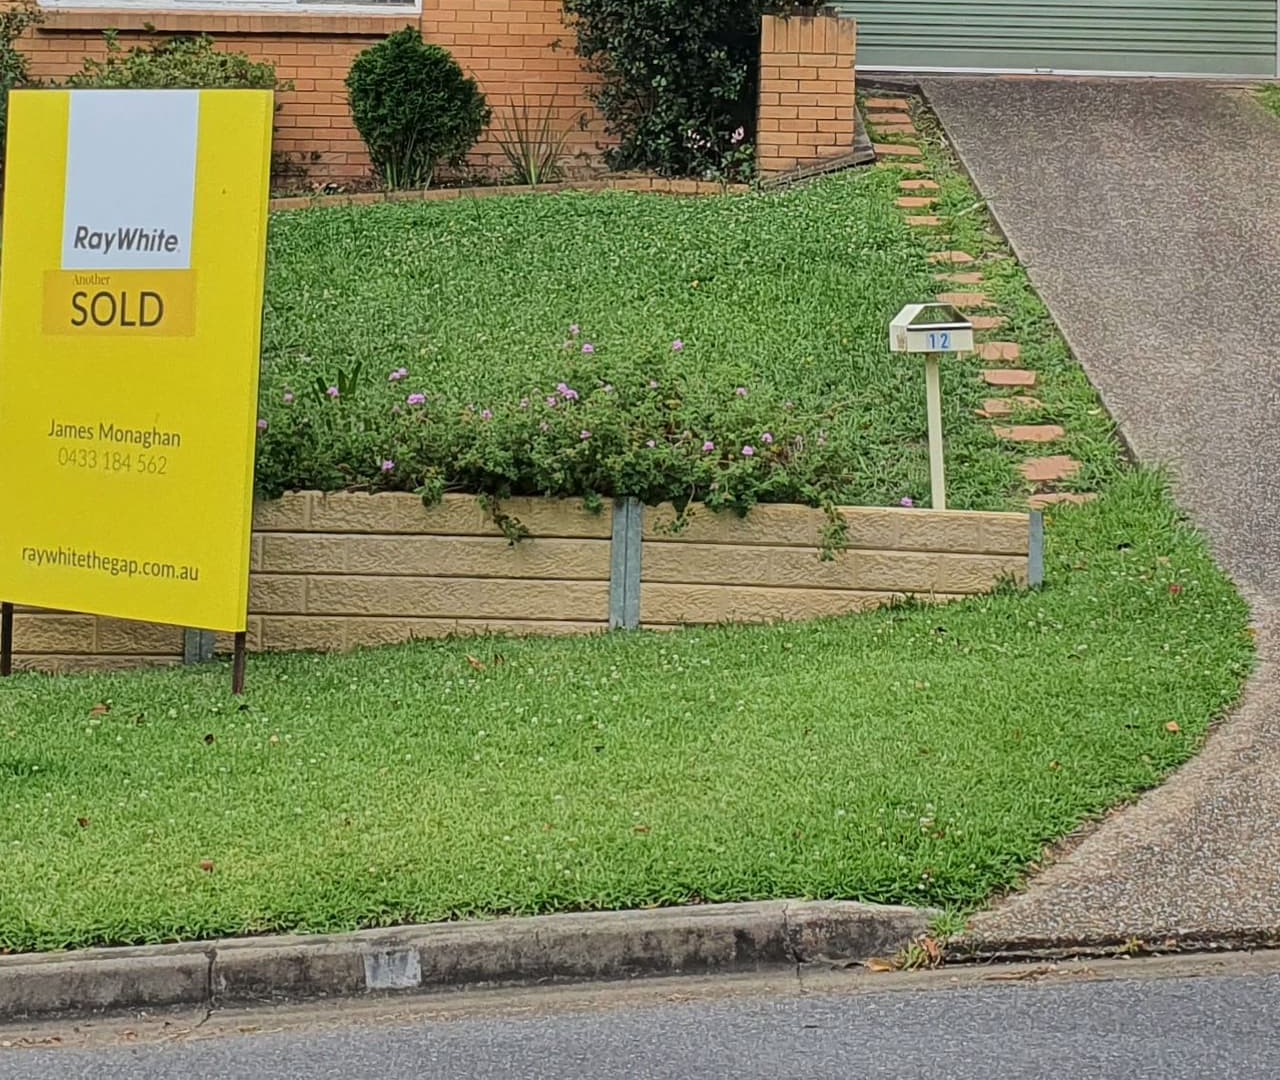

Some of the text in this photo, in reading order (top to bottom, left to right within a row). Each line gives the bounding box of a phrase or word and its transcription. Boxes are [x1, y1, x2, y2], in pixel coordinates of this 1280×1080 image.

[72, 274, 110, 286] Another
[71, 291, 164, 327] SOLD
[930, 333, 949, 349] 12
[48, 419, 181, 448] James Monaghan
[58, 447, 167, 475] 0433 184 562
[22, 545, 199, 581] raywhitethegap.com.au
